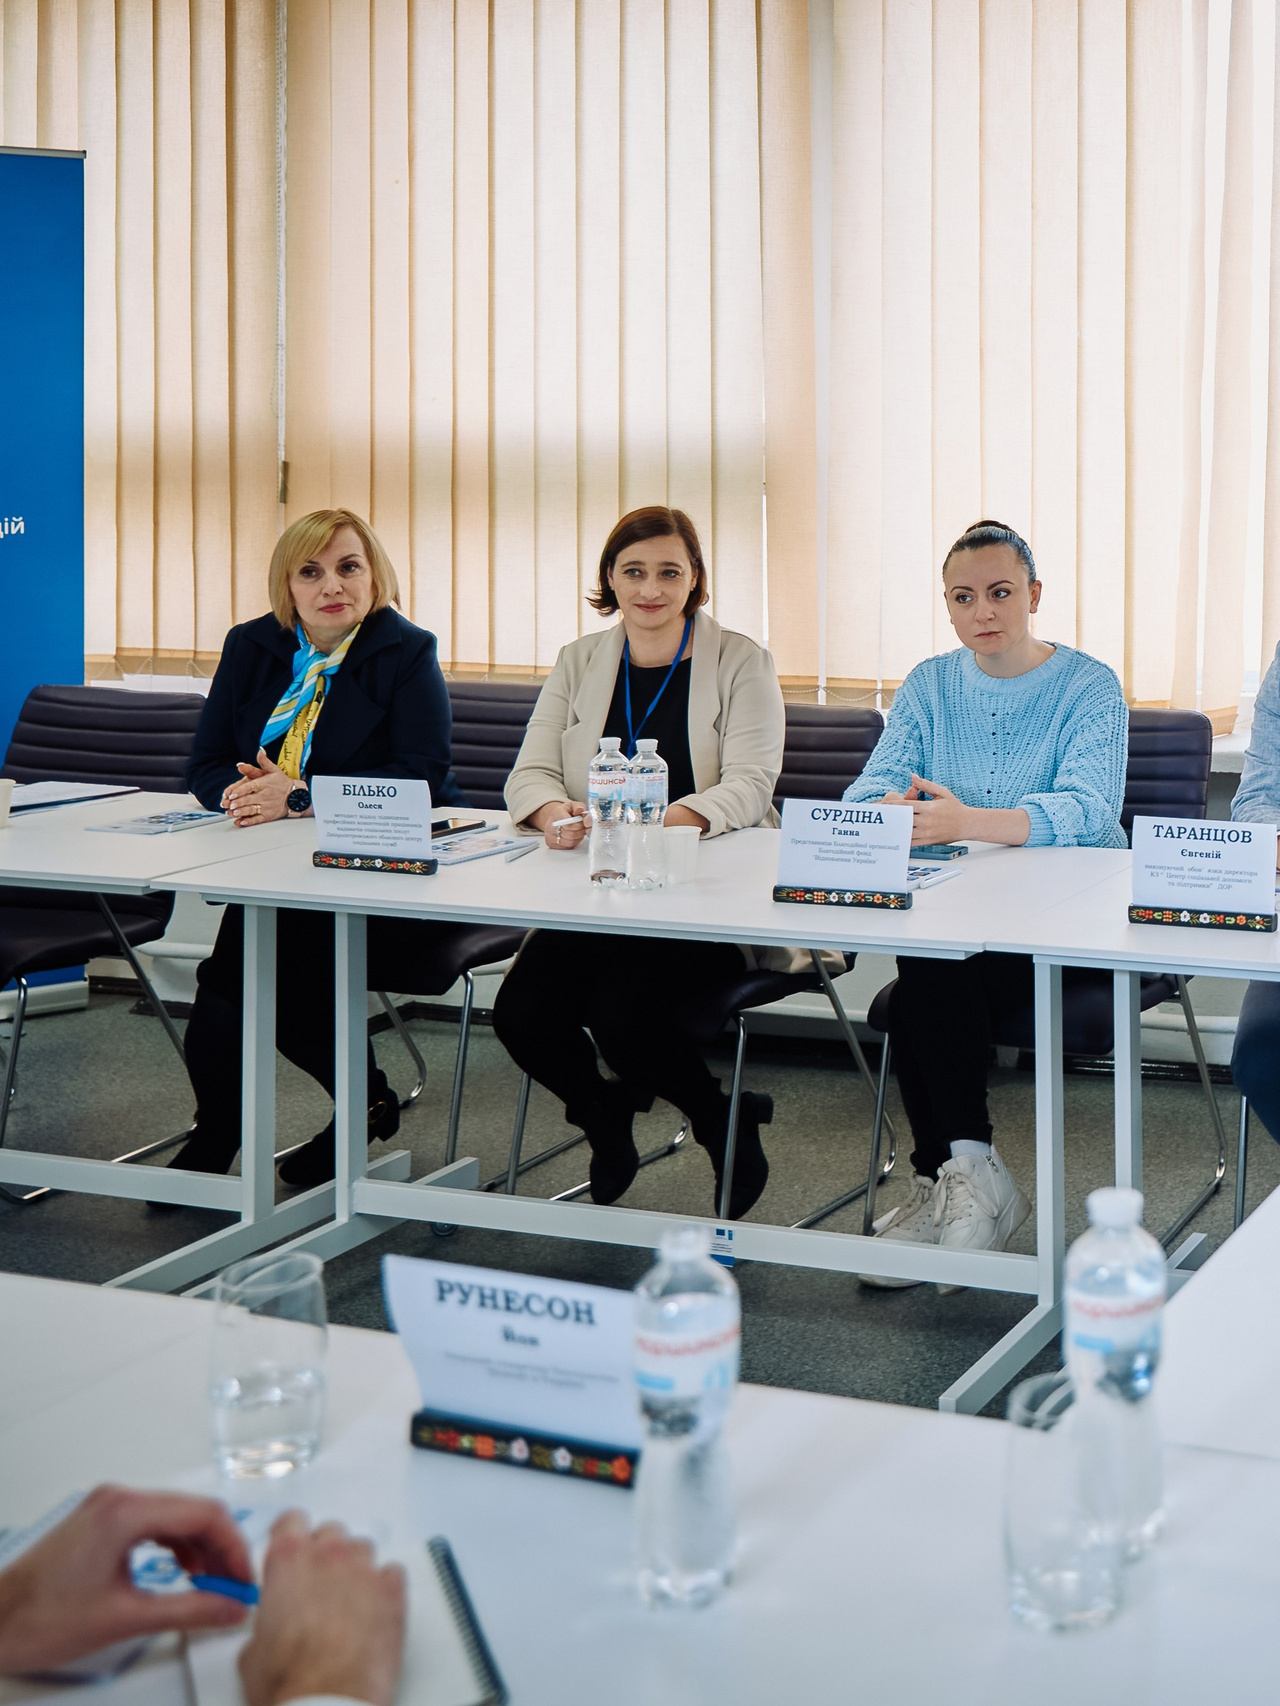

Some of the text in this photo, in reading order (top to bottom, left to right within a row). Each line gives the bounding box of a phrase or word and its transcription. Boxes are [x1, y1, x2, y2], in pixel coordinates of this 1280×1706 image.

[342, 784, 397, 798] БІЛЬКО
[358, 802, 383, 810] Олеся
[811, 808, 884, 825] СУРДІНА
[832, 828, 860, 836] Ганна
[1153, 824, 1253, 844] ТАРАНЦОВ
[1181, 849, 1222, 859] Євгеній
[436, 1278, 596, 1326] РУНЕСОН
